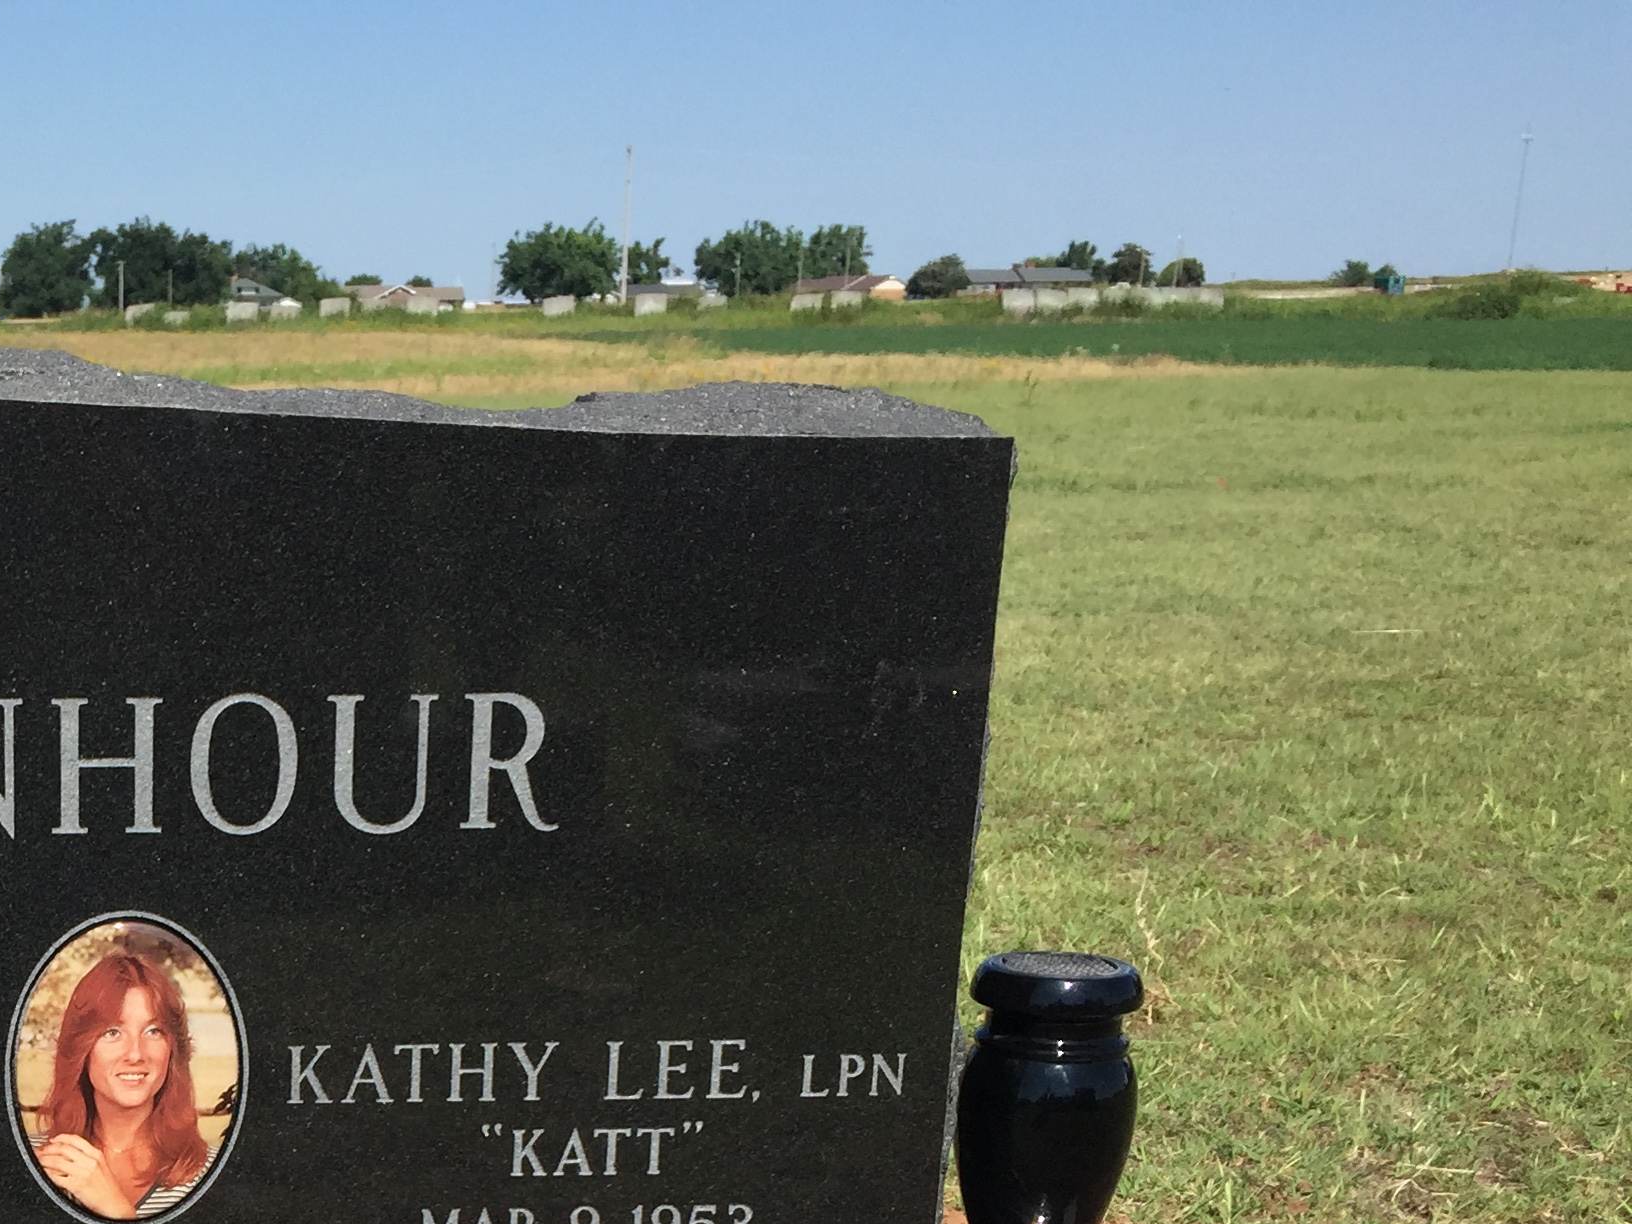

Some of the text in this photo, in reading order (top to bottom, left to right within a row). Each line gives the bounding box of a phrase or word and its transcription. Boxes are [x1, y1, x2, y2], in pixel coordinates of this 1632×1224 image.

[286, 1039, 908, 1105] KATHY LEE, LPN
